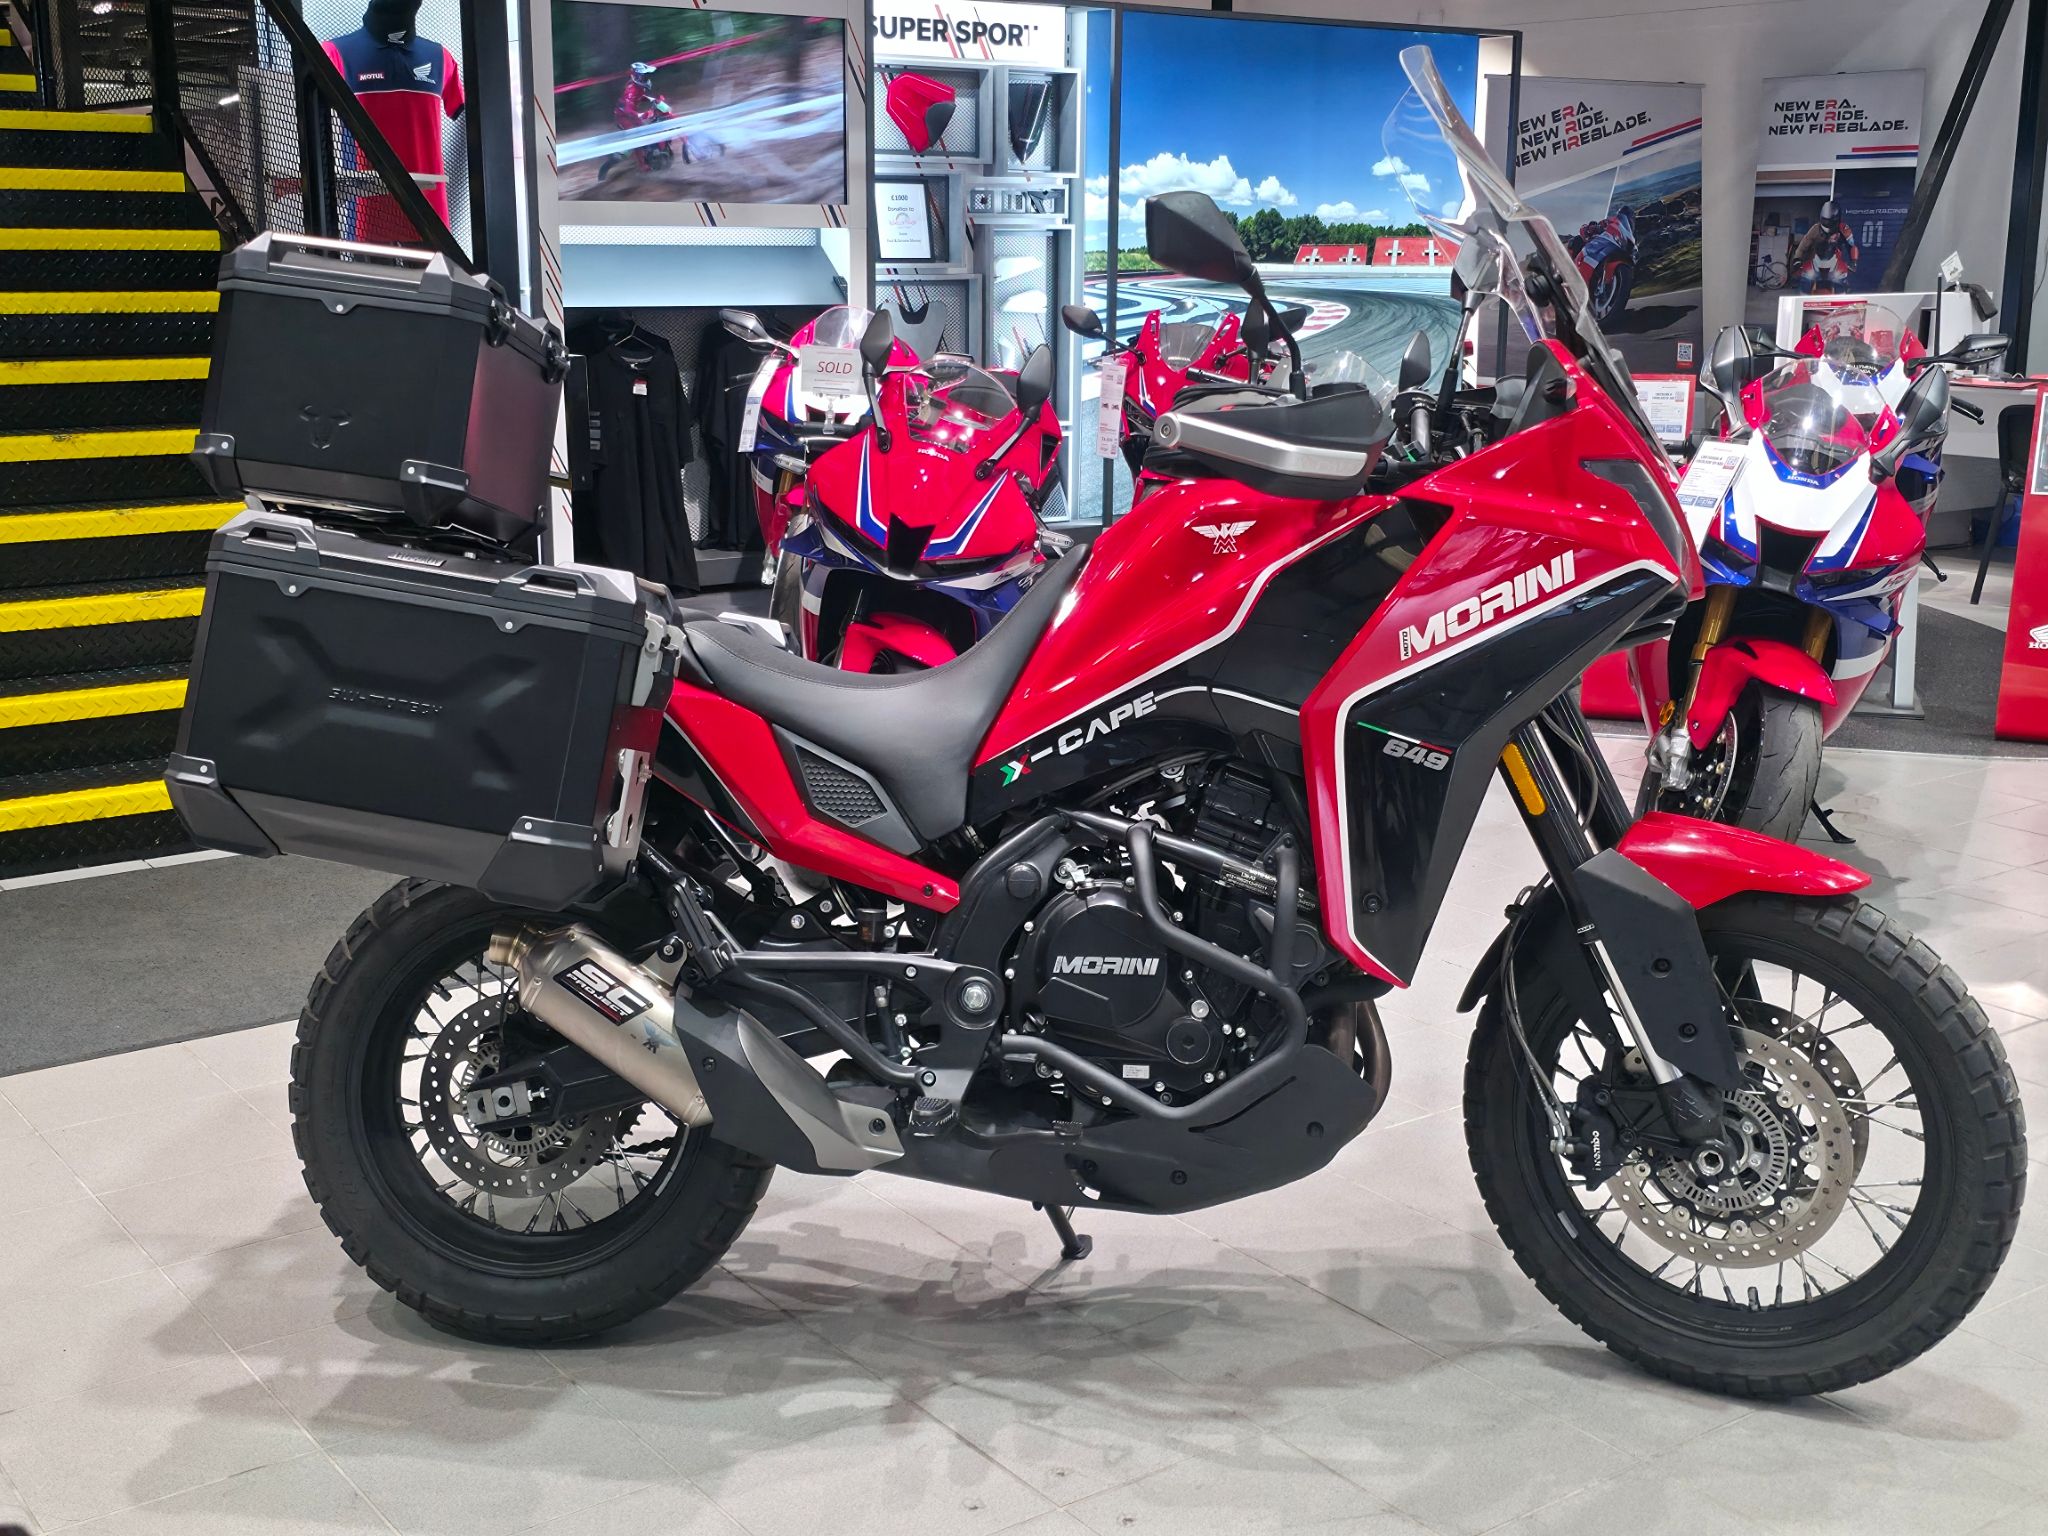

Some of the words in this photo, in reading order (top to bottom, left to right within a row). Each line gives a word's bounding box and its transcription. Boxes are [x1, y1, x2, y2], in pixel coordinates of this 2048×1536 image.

[955, 20, 1039, 47] SPOR
[359, 73, 384, 81] MOTUL
[1516, 114, 1546, 136] EW
[1551, 100, 1594, 124] ERA.
[1774, 101, 1810, 112] NEW
[1815, 98, 1857, 111] ERA.
[1783, 111, 1820, 123] NEW
[1824, 110, 1869, 121] RIDE.
[1521, 126, 1559, 150] NEW
[1565, 110, 1609, 135] RIDE.
[1552, 111, 1652, 156] FIREBLADE.
[1768, 125, 1804, 136] NEW
[1809, 120, 1909, 134] FIREBLADE.
[1862, 220, 1884, 247] 01
[817, 361, 853, 375] SOLD
[1402, 631, 1410, 657] MOTO
[1409, 549, 1576, 654] MORINI
[1000, 691, 1157, 788] X-CAPE
[1382, 738, 1450, 771] 649
[1053, 955, 1160, 976] MORINI
[566, 972, 629, 1017] PROJECT
[571, 963, 647, 1015] SC
